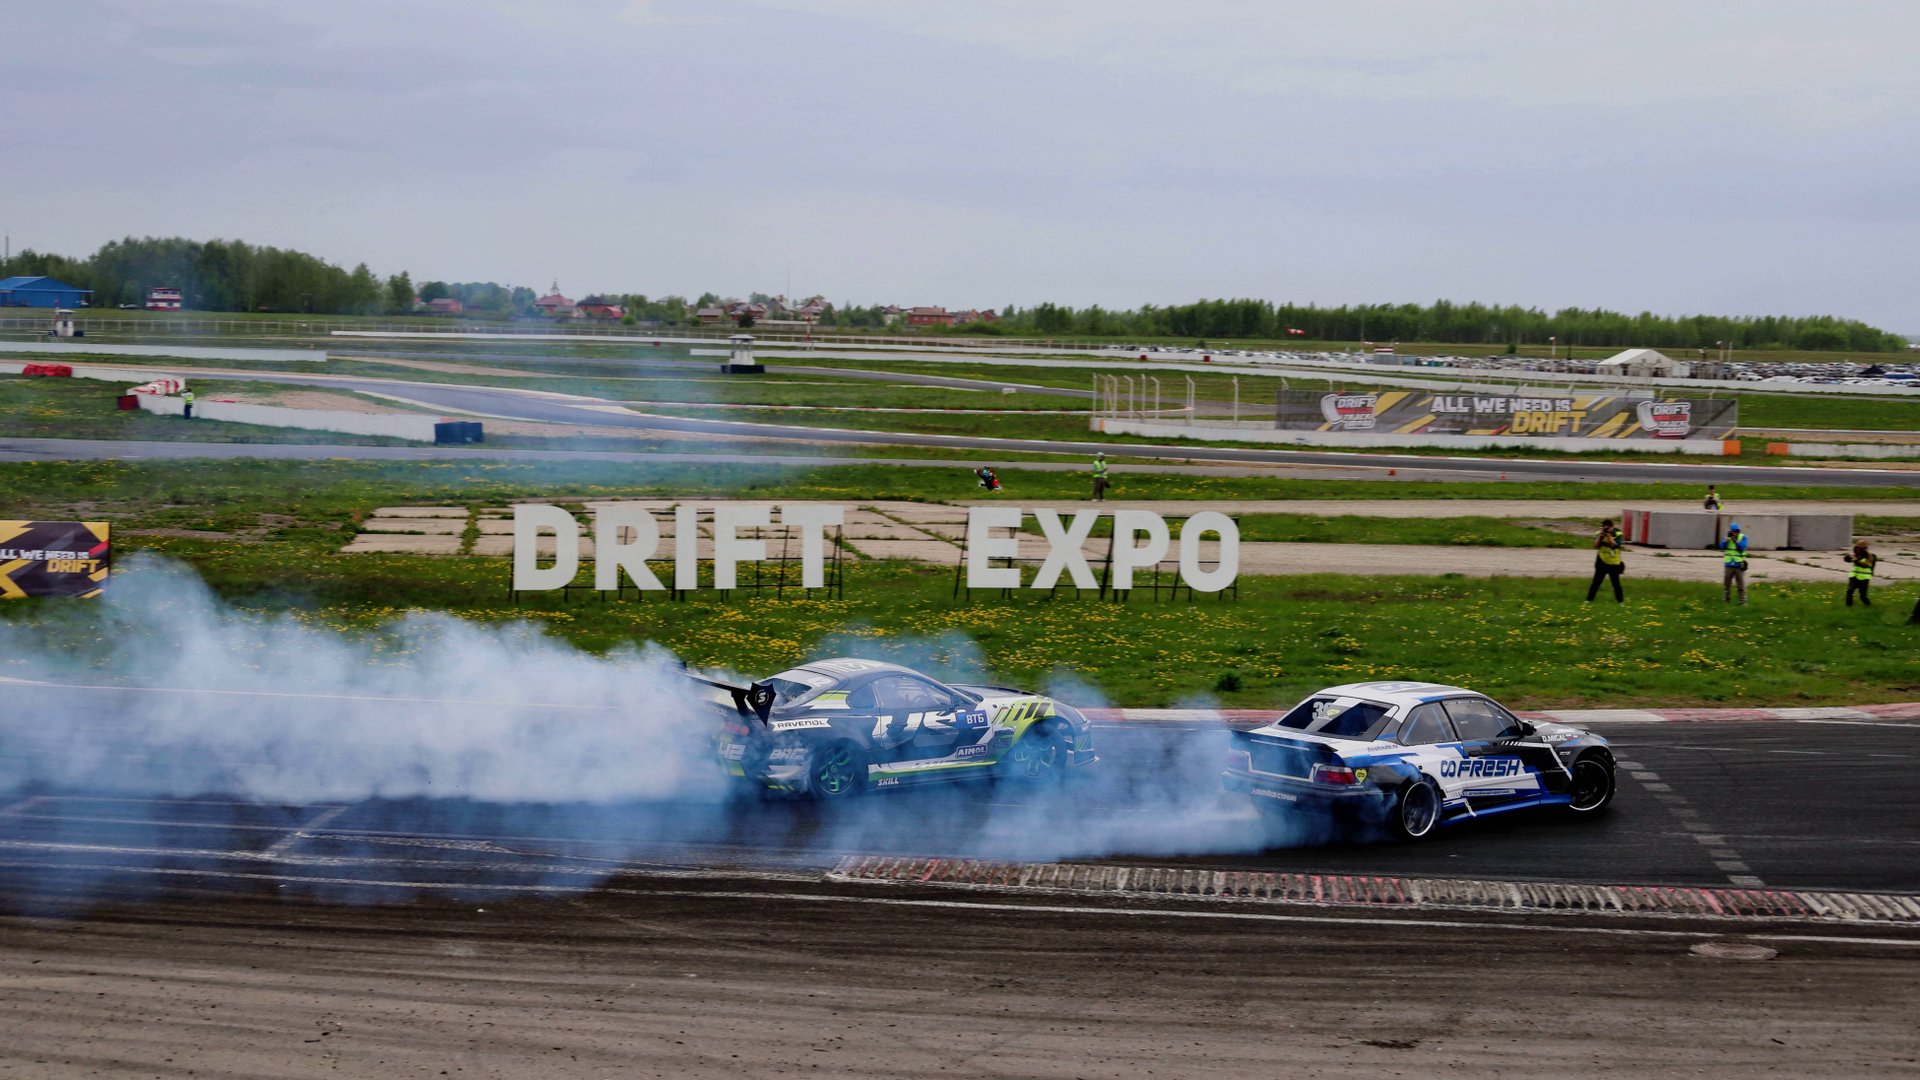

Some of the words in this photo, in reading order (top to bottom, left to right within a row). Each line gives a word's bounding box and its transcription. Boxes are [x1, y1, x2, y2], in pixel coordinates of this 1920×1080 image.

[1337, 397, 1376, 408] DRIFT
[1430, 397, 1471, 413] ALL
[1473, 398, 1506, 413] WE
[1509, 399, 1553, 413] NEED
[1555, 400, 1571, 412] IS
[1653, 404, 1690, 415] DRIFT
[1511, 411, 1588, 434] DRIFT
[0, 549, 18, 560] LL
[20, 550, 44, 560] WE
[513, 505, 845, 591] DRIFT
[967, 506, 1241, 593] EXPO
[47, 560, 100, 573] DRIFT
[777, 720, 825, 728] RAVENOL
